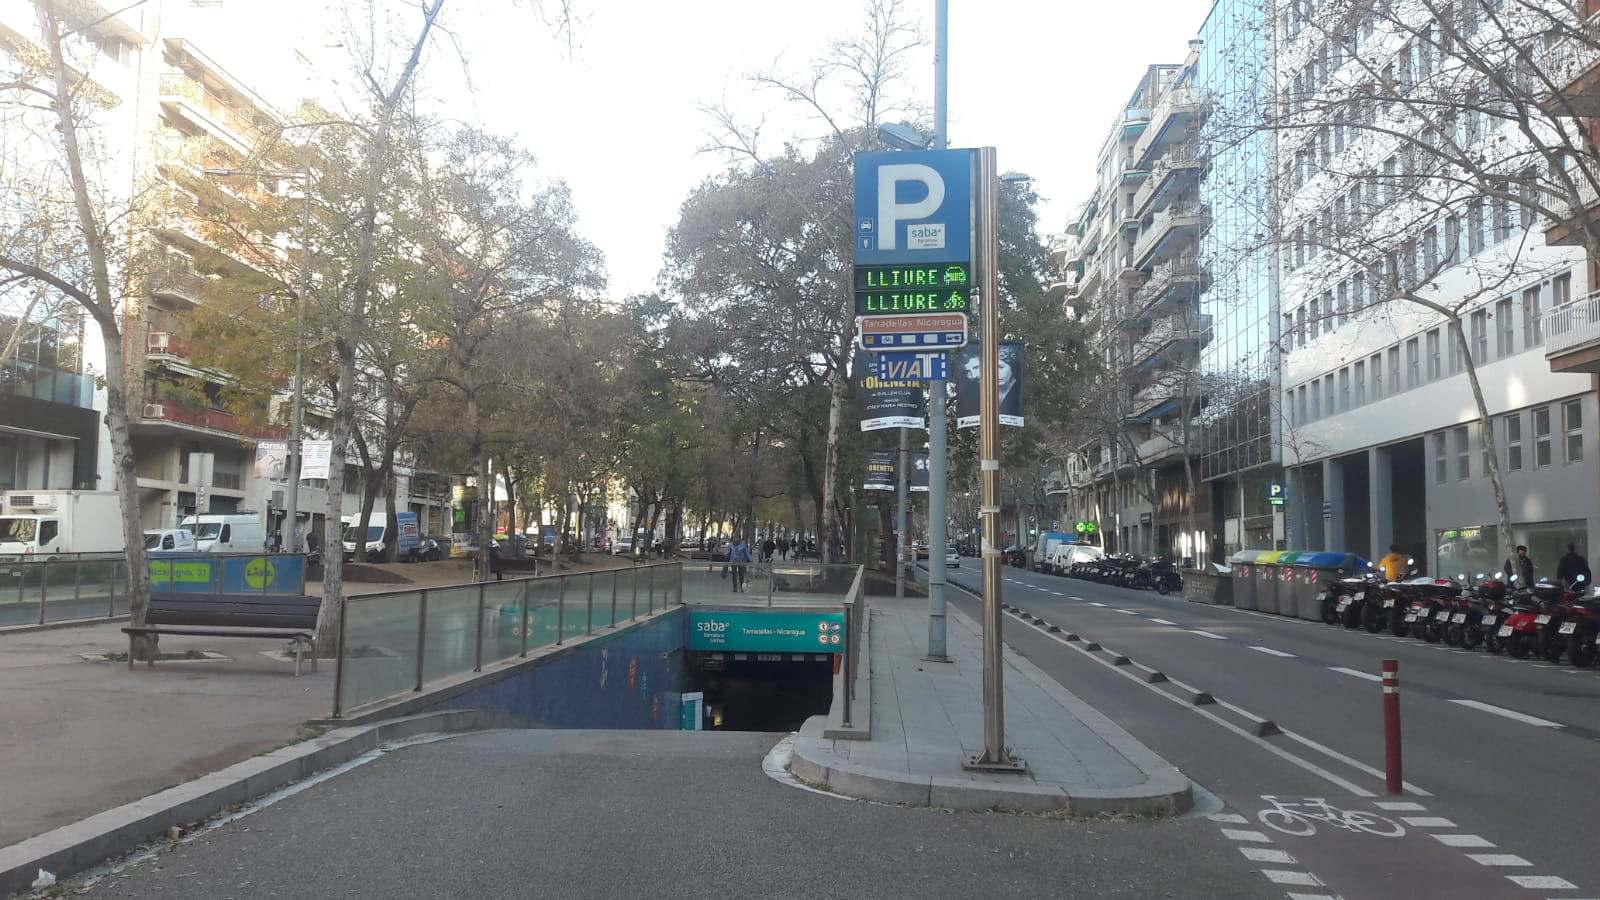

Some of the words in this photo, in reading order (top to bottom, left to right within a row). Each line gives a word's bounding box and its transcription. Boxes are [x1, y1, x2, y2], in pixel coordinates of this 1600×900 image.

[878, 163, 945, 250] P
[911, 226, 938, 238] saba
[867, 269, 938, 287] LLIURE
[867, 293, 938, 311] LLIURE
[864, 319, 913, 328] Tarradellas
[916, 318, 963, 328] Nicaragua
[1271, 484, 1281, 496] P
[697, 620, 725, 631] saba
[777, 628, 805, 636] Nicaragua
